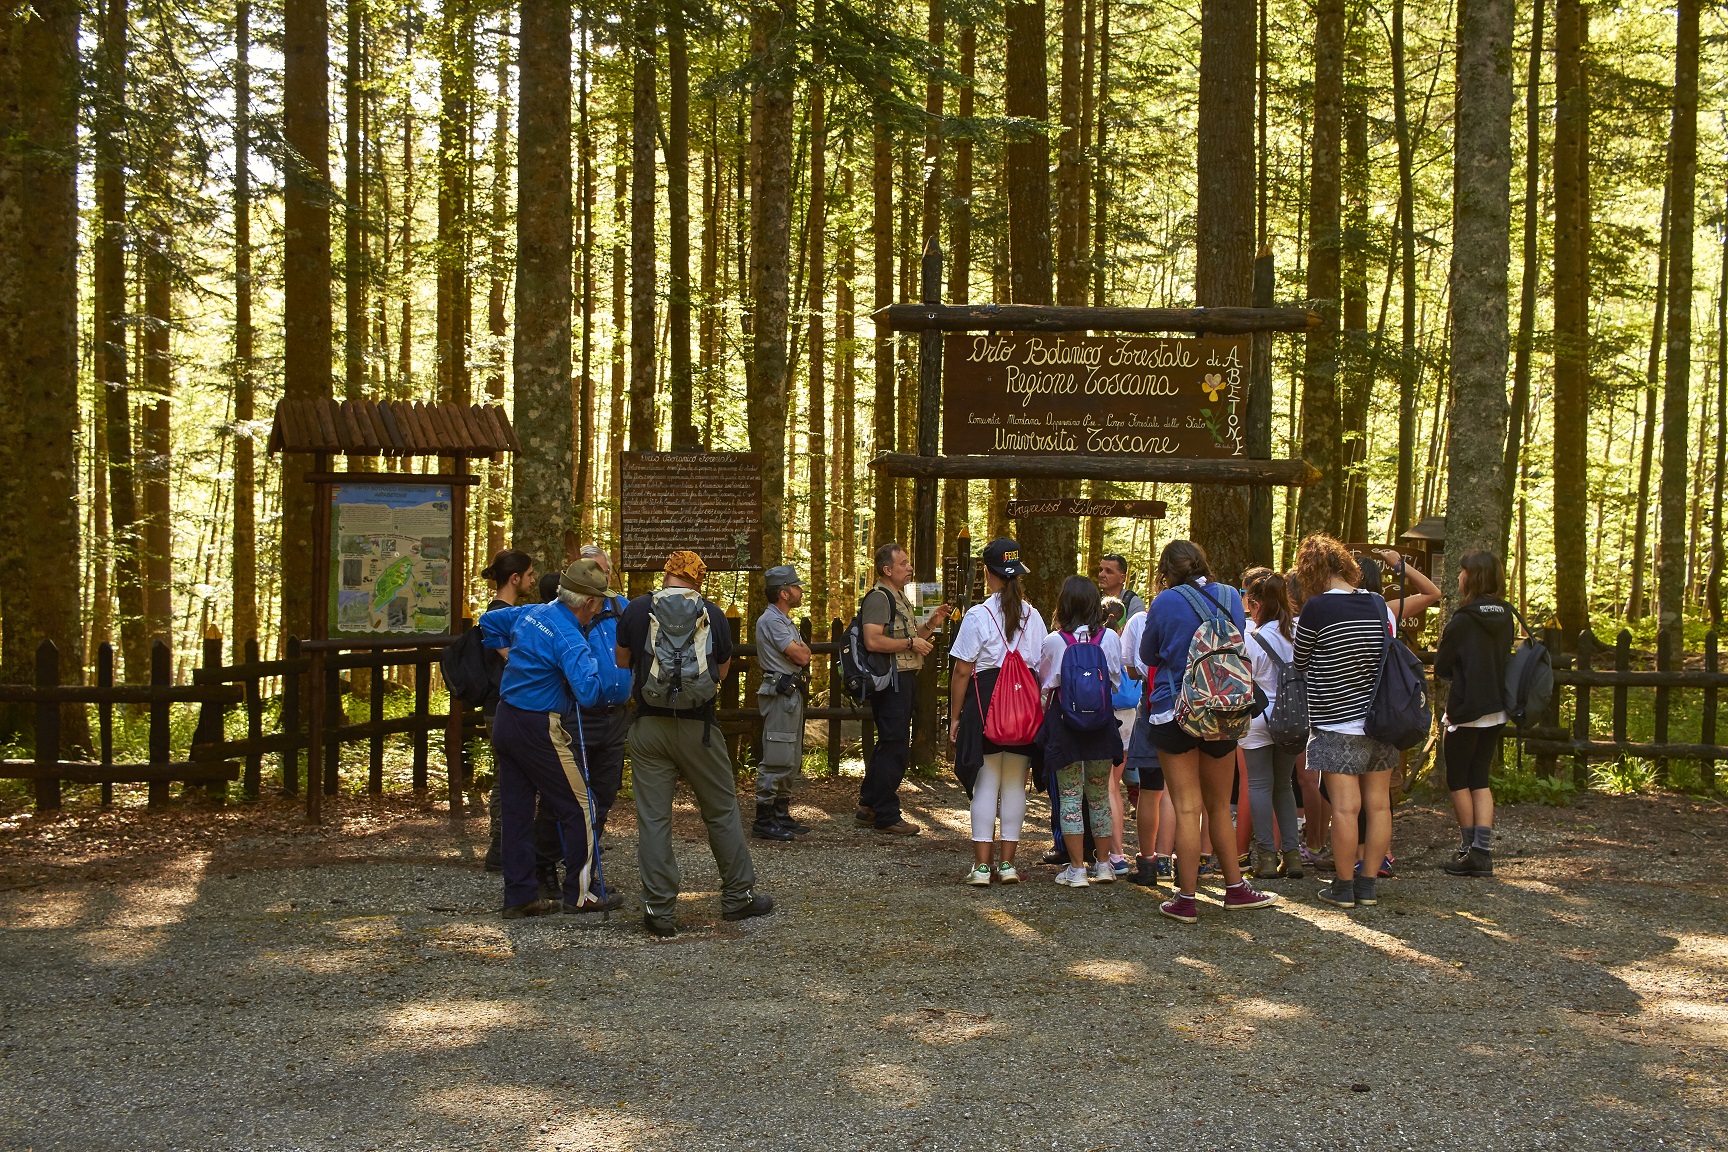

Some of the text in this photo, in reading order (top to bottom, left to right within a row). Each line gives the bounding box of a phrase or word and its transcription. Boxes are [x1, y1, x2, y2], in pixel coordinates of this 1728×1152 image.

[967, 337, 1221, 368] Orto Botanico Forestale di
[1005, 365, 1179, 407] Regione Toscana
[1222, 345, 1244, 456] ABETONE
[1006, 413, 1042, 426] Montana
[1105, 413, 1125, 431] Corpo
[1128, 412, 1160, 428] Forestale
[1163, 416, 1180, 428] dello
[1185, 415, 1206, 429] Stato
[990, 427, 1180, 454] Università Toscane
[662, 454, 697, 463] Botanico
[1007, 498, 1117, 518] Ingresso Libero
